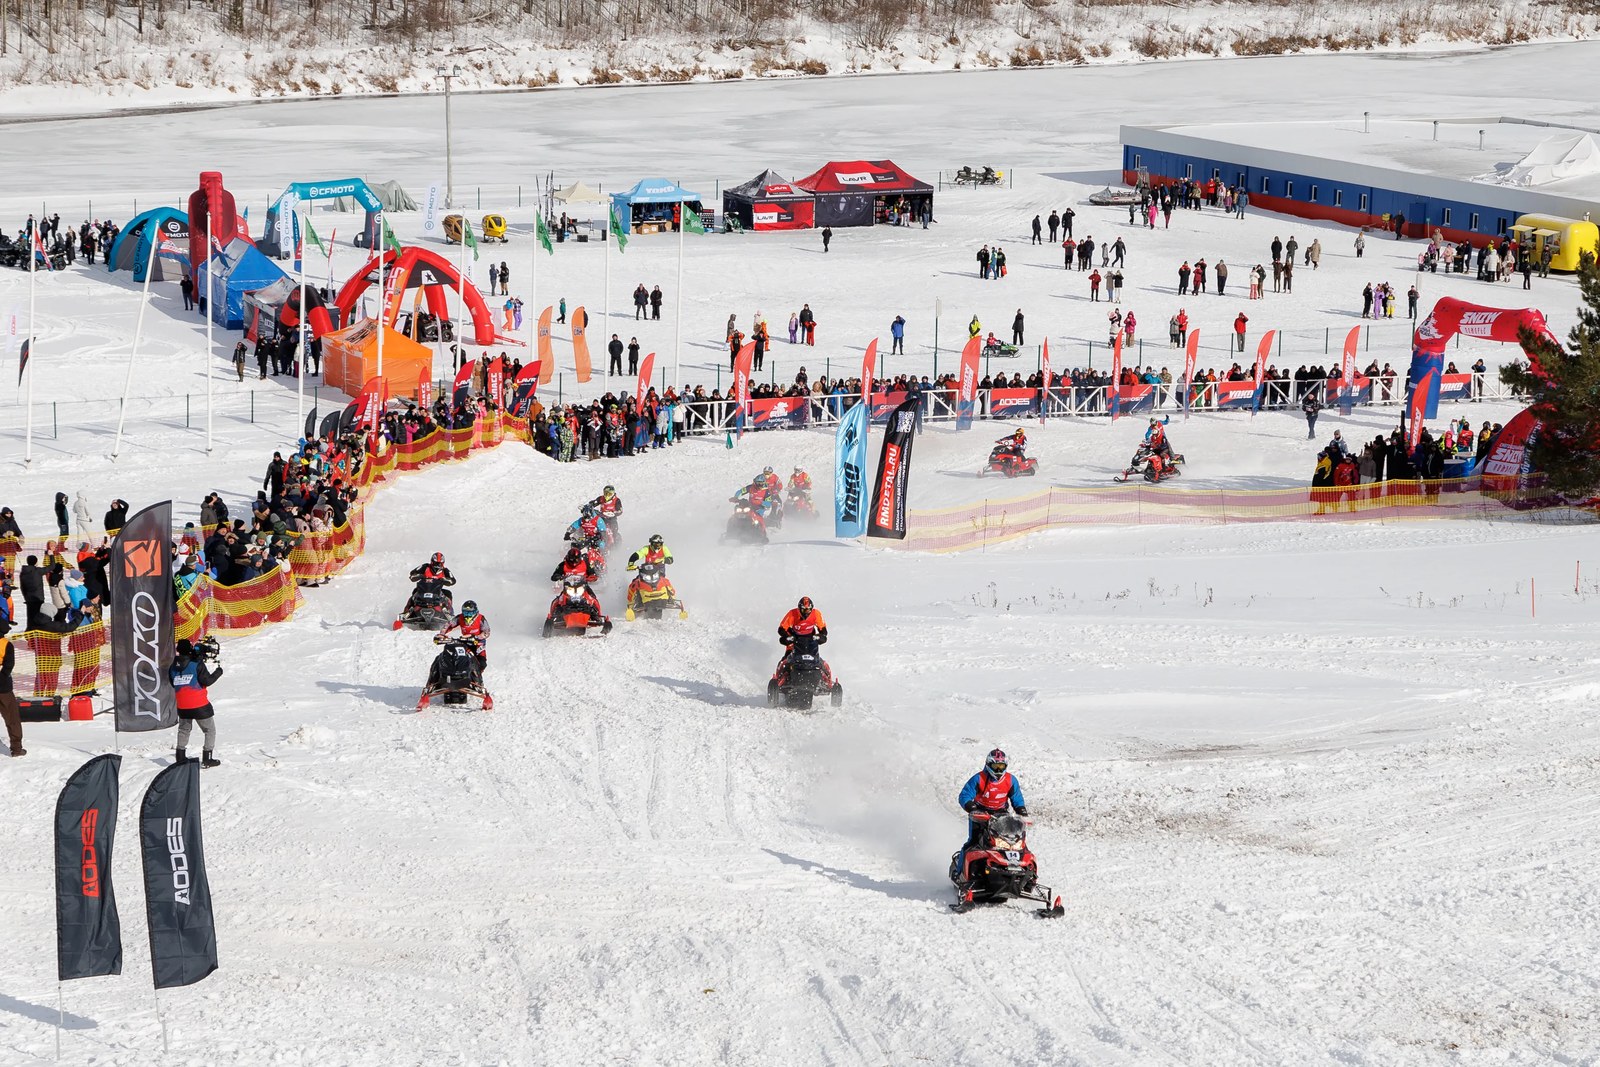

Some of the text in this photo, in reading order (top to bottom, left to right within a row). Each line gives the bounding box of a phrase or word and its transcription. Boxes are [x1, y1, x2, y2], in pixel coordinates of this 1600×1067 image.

[318, 185, 355, 196] CFMOTO
[428, 186, 437, 218] CFMOTO
[645, 185, 675, 194] YOKO
[1459, 311, 1503, 324] SNOW
[998, 398, 1030, 406] AODES
[842, 461, 860, 524] YOKO
[879, 446, 898, 527] RMDETAL.RU
[131, 591, 161, 722] YOKO
[81, 808, 99, 897] AODES
[166, 816, 190, 905] AODES
